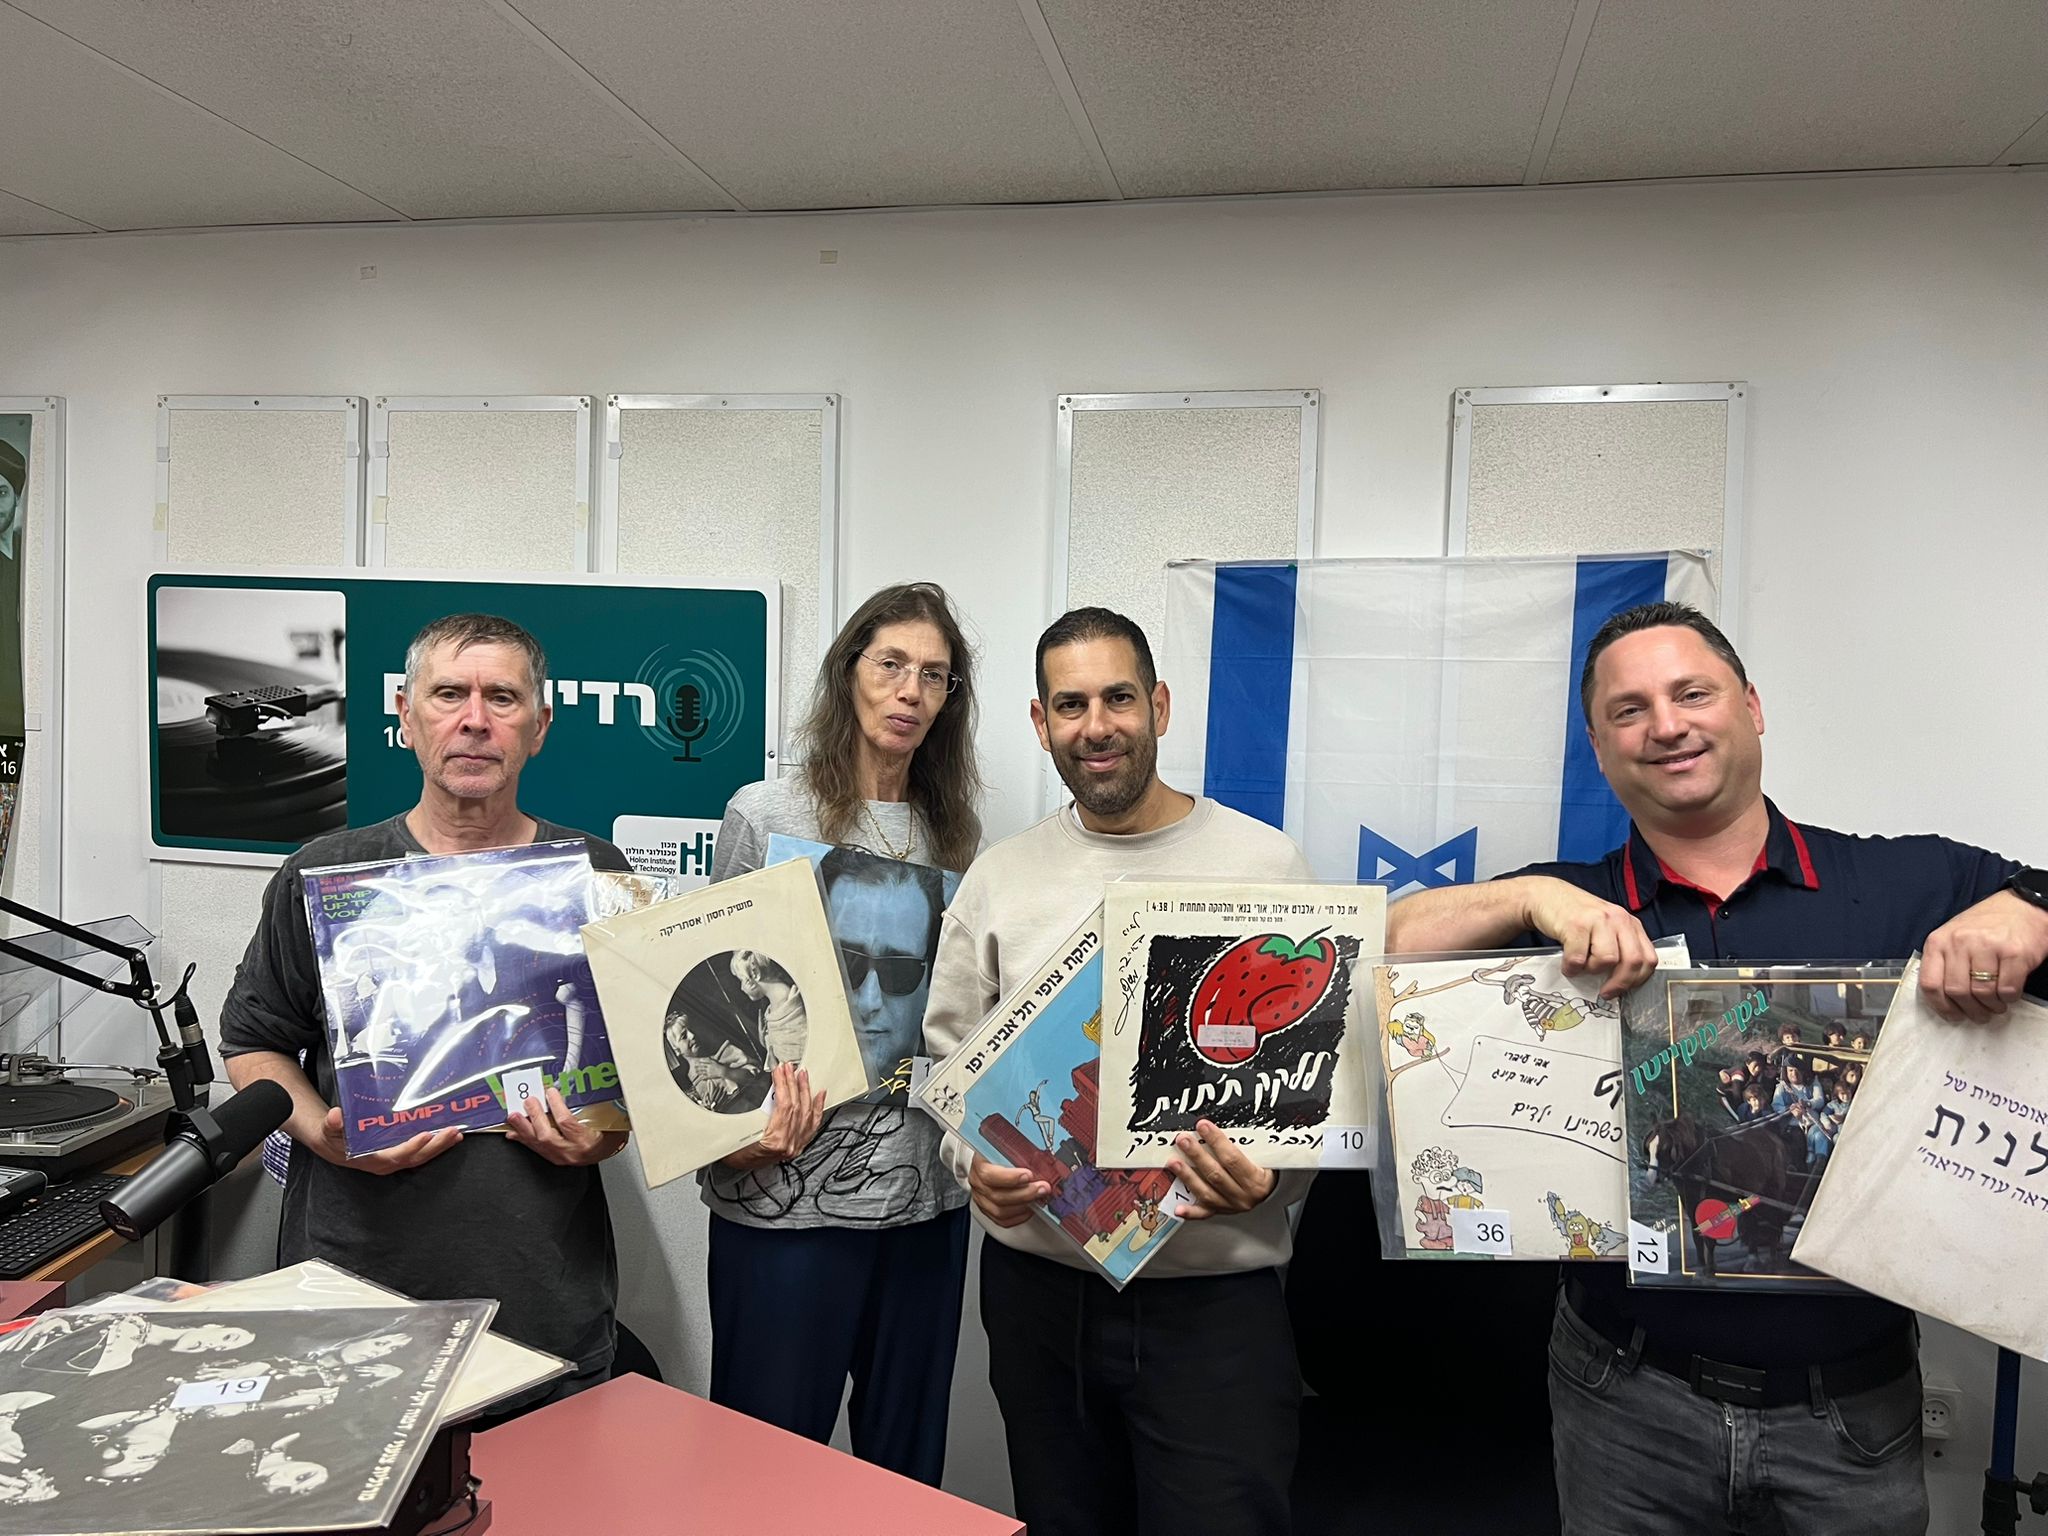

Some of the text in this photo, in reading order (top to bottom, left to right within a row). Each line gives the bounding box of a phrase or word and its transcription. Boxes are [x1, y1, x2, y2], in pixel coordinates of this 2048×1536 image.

[625, 847, 677, 857] טכנולוגי חולון
[661, 841, 677, 849] מכון
[629, 856, 676, 866] Holon Institute
[639, 864, 677, 875] Technology
[322, 889, 373, 903] PUMP
[323, 901, 349, 911] UP
[1236, 902, 1251, 914] בנאי
[1253, 903, 1268, 914] אורי
[1291, 904, 1315, 915] אלברט
[1336, 904, 1346, 915] כל
[1347, 904, 1359, 915] את
[659, 899, 753, 937] מושיק חסון אסתריקה
[1062, 930, 1098, 971] להקת
[1034, 969, 1065, 997] צופי
[1533, 1057, 1550, 1069] אבי
[1253, 1051, 1332, 1115] ללקק
[1520, 1074, 1549, 1087] ליאור
[518, 1082, 529, 1099] 8
[1943, 1070, 2048, 1125] אופטימית של
[357, 1094, 491, 1132] PUMP UP
[1511, 1102, 1552, 1124] ילדים
[1339, 1131, 1364, 1150] 10
[1924, 1103, 2048, 1177] לנית
[1980, 1172, 2010, 1194] עוד
[1477, 1223, 1505, 1243] 36
[1637, 1237, 1659, 1263] 12
[216, 1379, 257, 1395] 19
